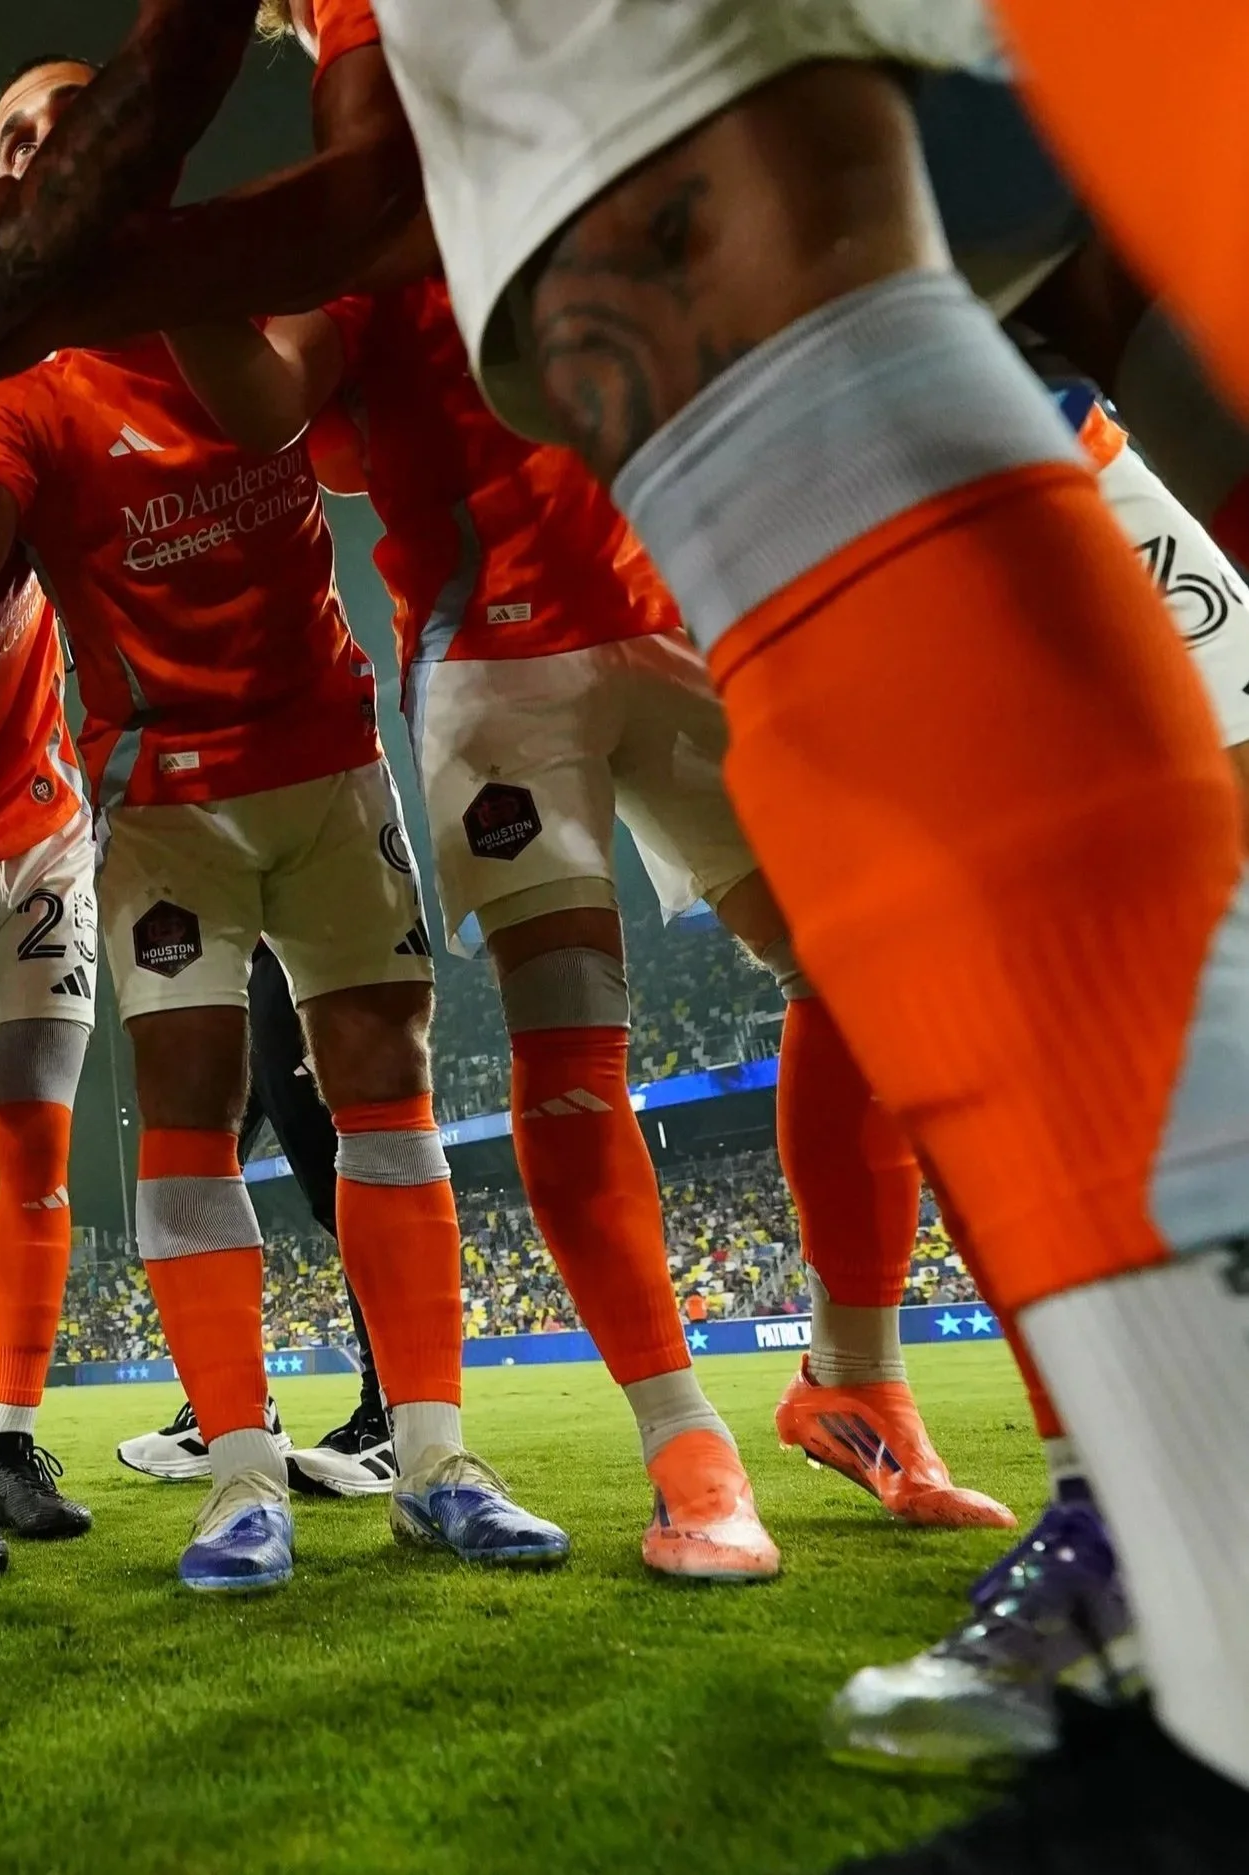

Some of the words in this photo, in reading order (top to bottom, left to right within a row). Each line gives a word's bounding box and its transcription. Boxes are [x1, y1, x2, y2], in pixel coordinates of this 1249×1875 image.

[120, 492, 184, 539] MD
[188, 451, 303, 518] Anderson
[123, 515, 236, 571] Cancer
[476, 819, 533, 848] HOUSTON
[142, 943, 195, 960] HOUSTON
